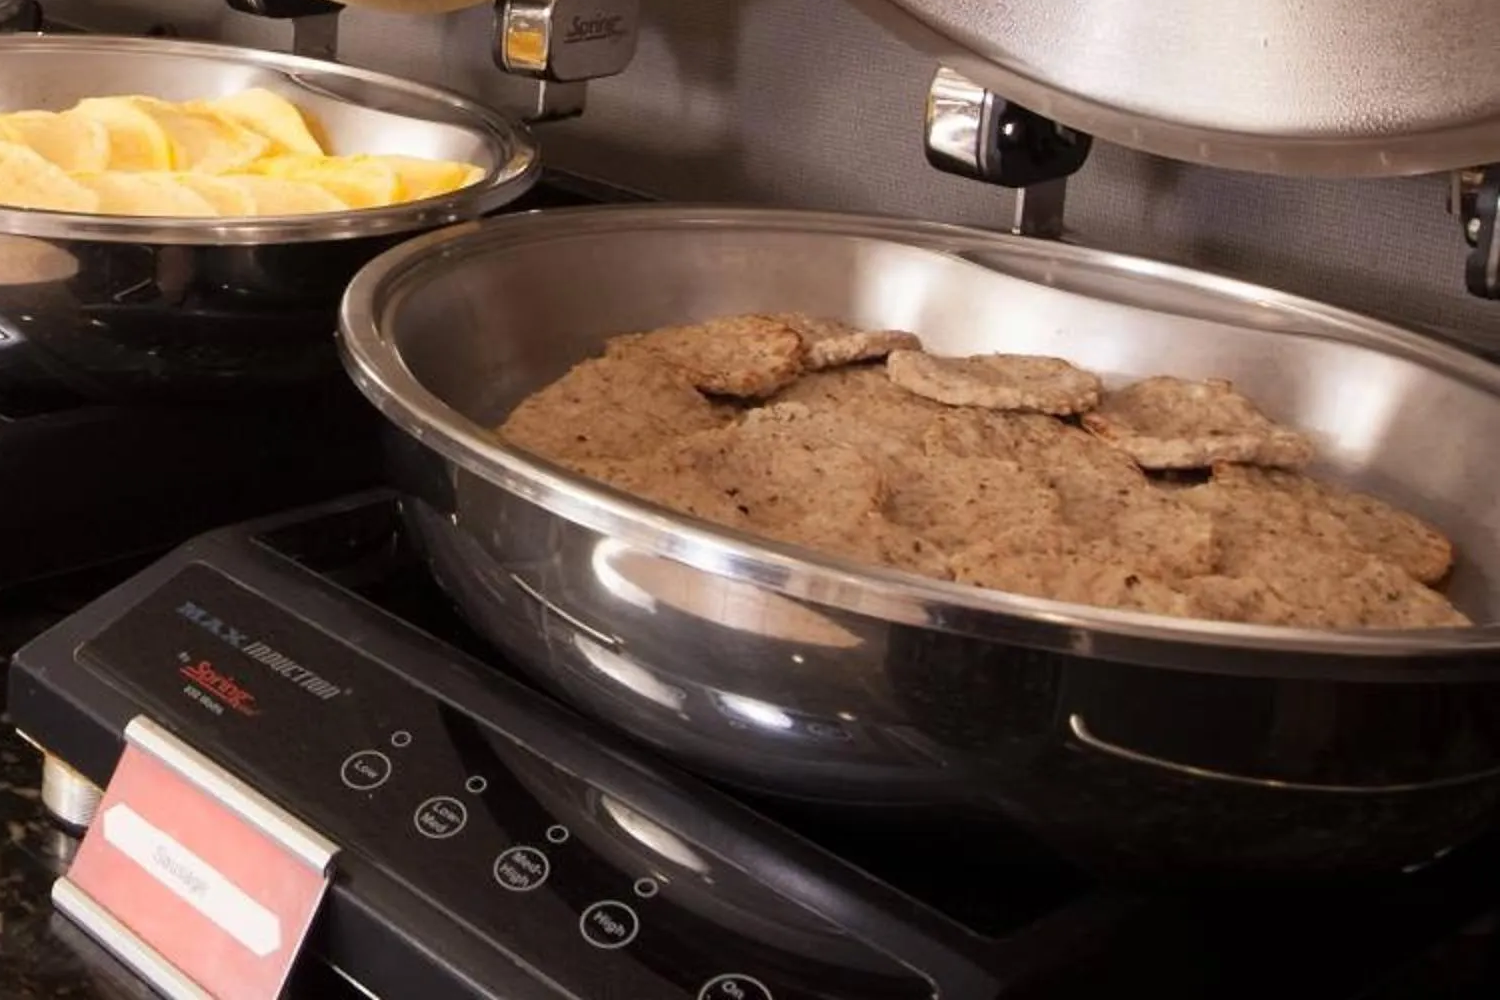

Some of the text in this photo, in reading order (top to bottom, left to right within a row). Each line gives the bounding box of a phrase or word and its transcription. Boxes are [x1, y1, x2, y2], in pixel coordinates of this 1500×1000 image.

[180, 660, 263, 717] Spring
[353, 759, 378, 779] Low
[593, 910, 625, 937] High
